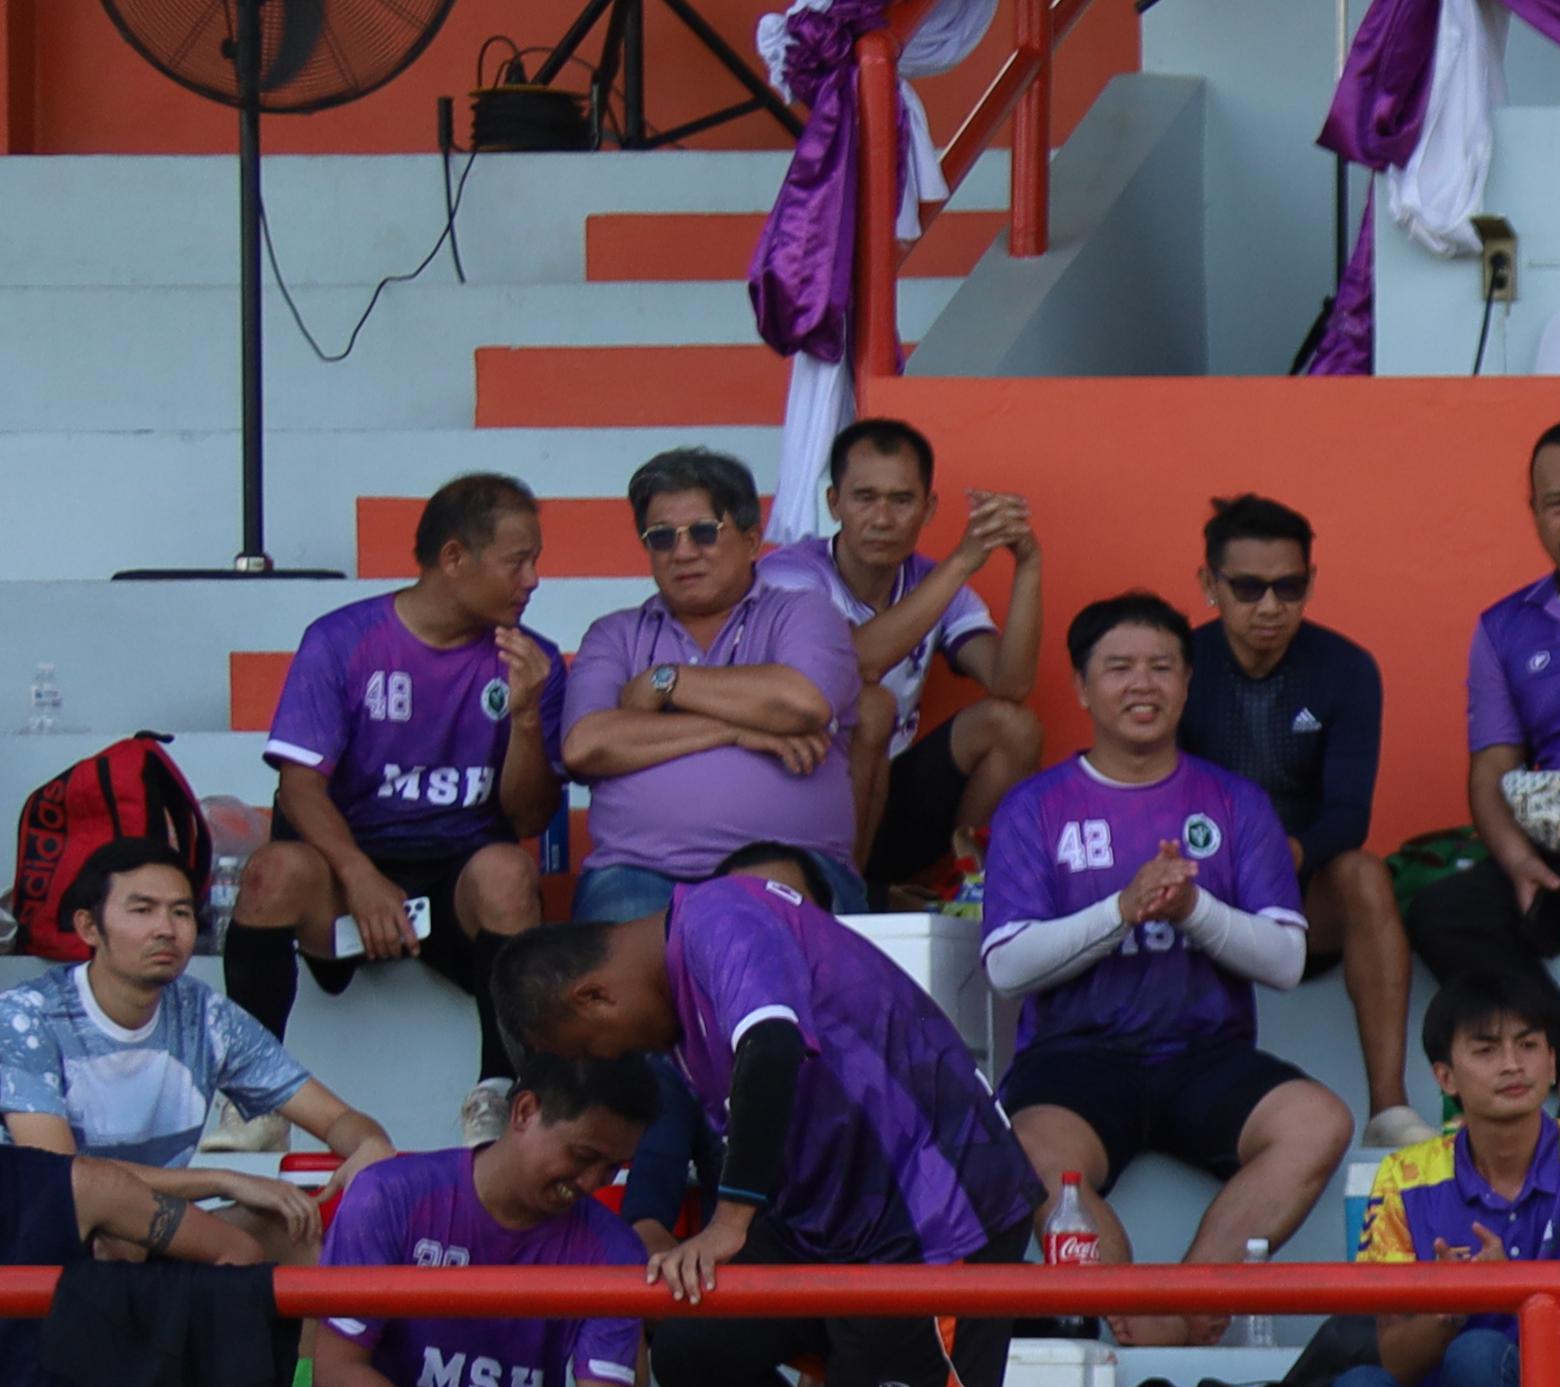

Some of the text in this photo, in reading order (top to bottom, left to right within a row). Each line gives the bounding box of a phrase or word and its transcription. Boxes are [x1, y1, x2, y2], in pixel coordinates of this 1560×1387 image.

[364, 670, 413, 722] 48
[377, 763, 495, 808] MSH
[1057, 818, 1115, 873] 48
